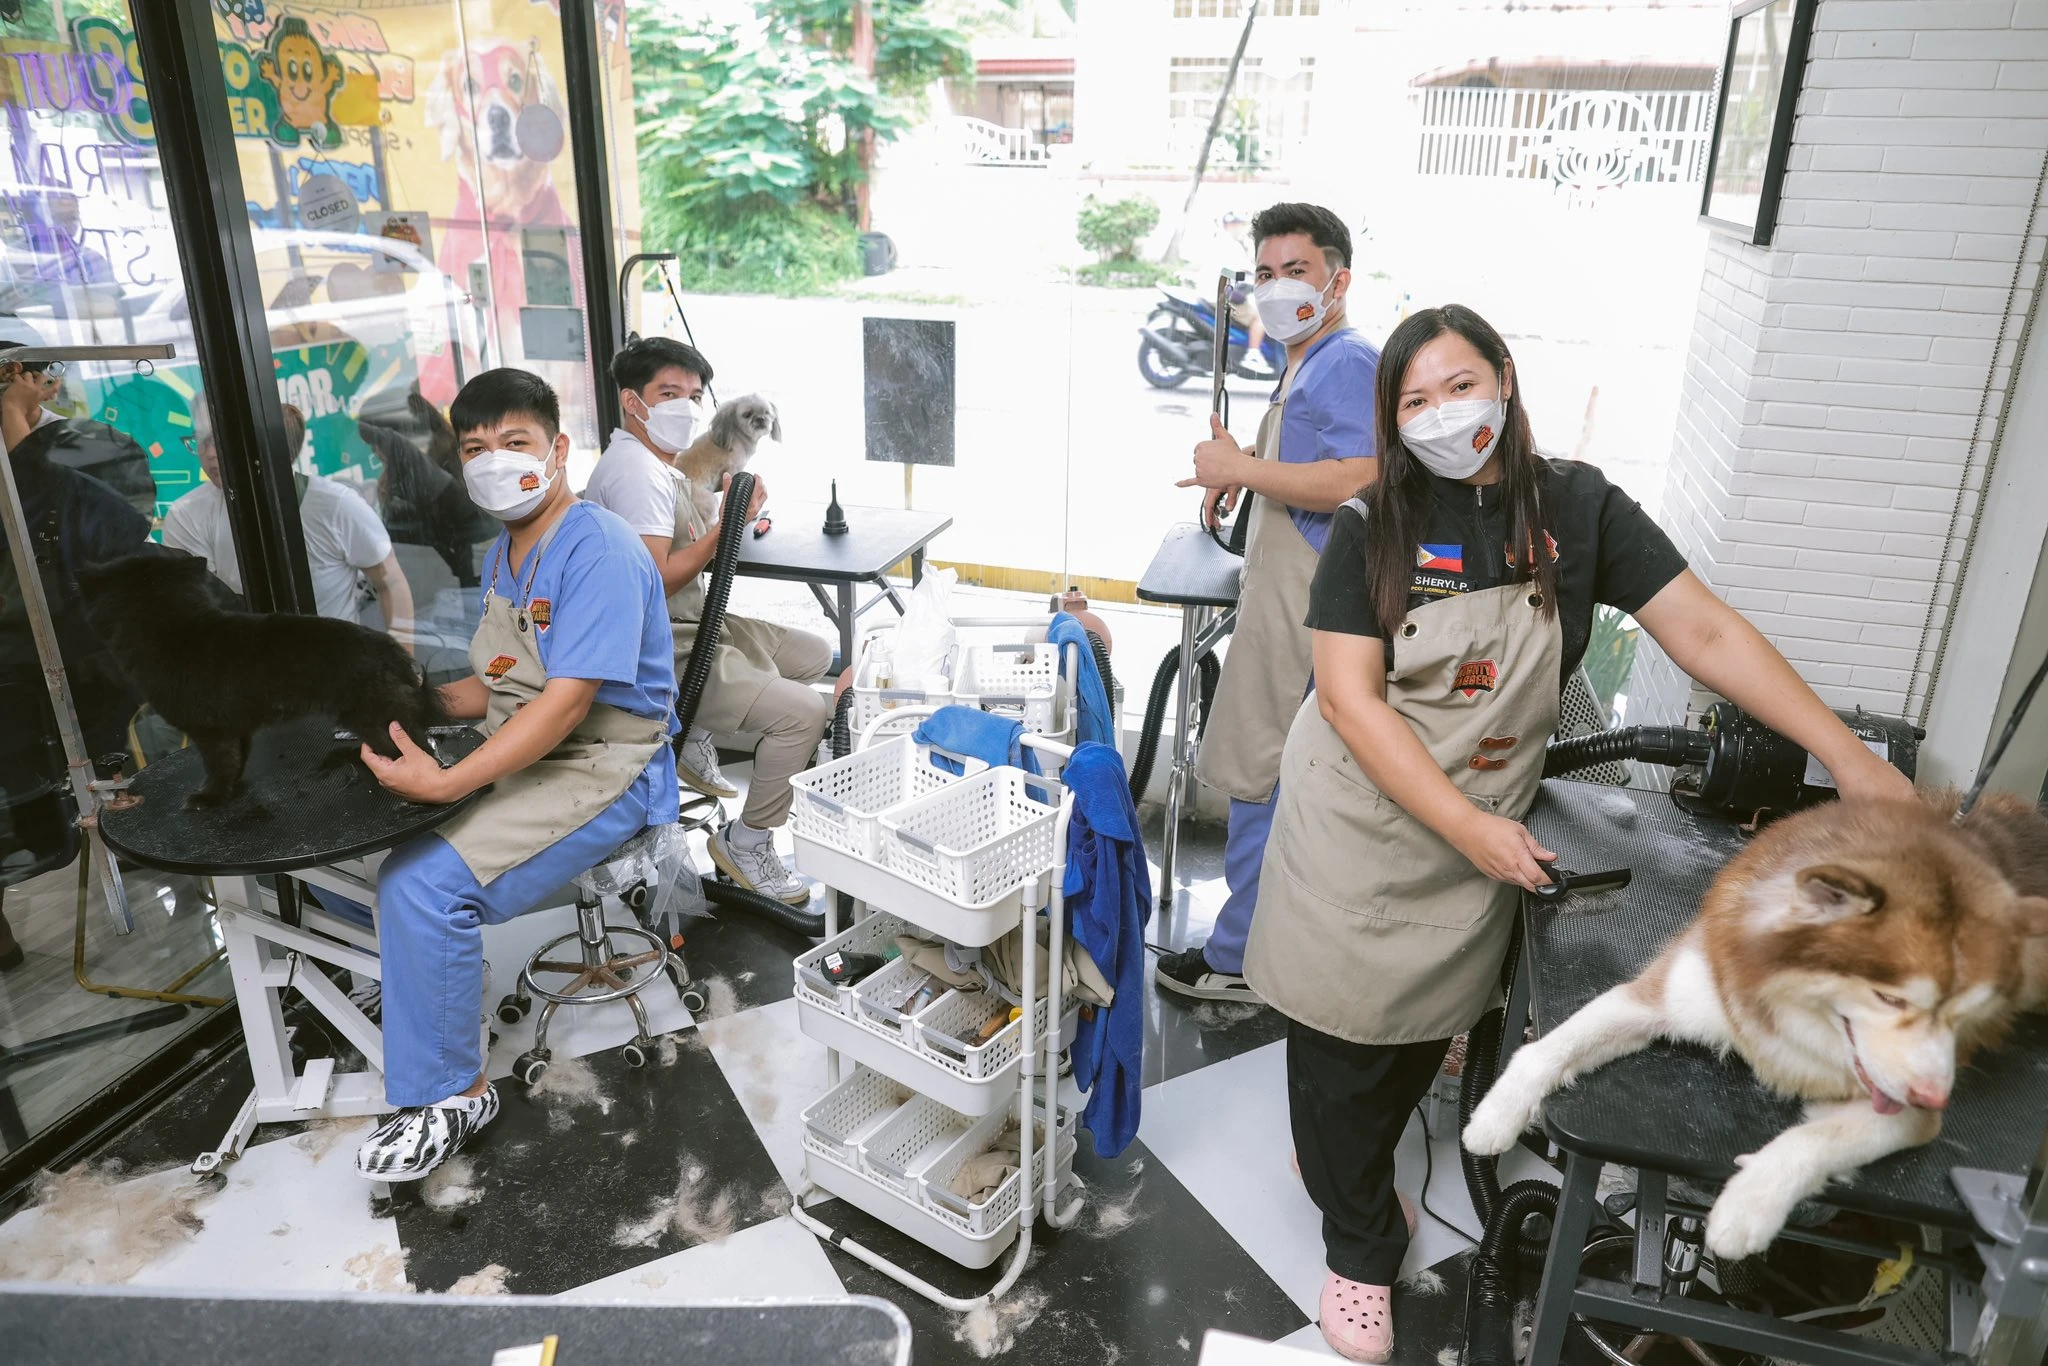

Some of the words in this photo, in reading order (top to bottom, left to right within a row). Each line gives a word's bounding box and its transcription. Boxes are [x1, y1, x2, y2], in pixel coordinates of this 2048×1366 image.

[307, 199, 349, 221] CLOSED
[1415, 576, 1458, 590] SHERYL
[1459, 582, 1470, 592] P.
